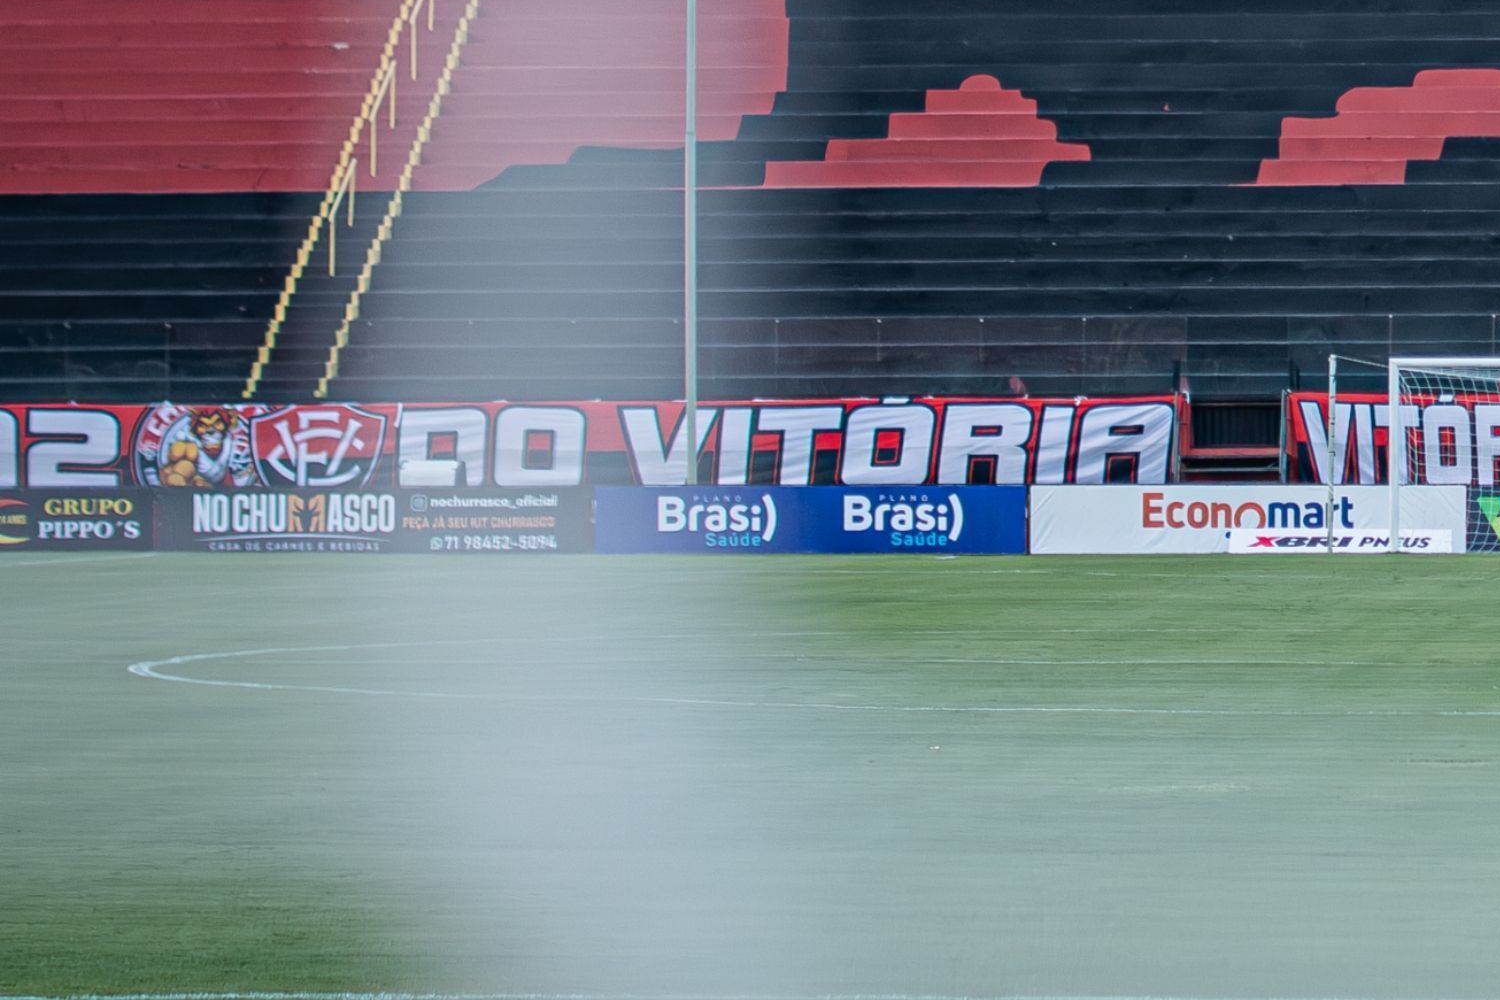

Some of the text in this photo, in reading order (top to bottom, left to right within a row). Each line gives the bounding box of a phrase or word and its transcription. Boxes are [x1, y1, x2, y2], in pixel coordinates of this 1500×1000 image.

[617, 396, 1174, 486] VITÓRIA
[879, 494, 928, 502] PLANO
[44, 498, 133, 516] GRUPO
[1142, 493, 1354, 528] Economart
[444, 536, 459, 550] 71
[705, 532, 761, 547] Saúde
[891, 532, 947, 546] Saúde
[1358, 537, 1431, 549] PNUS
